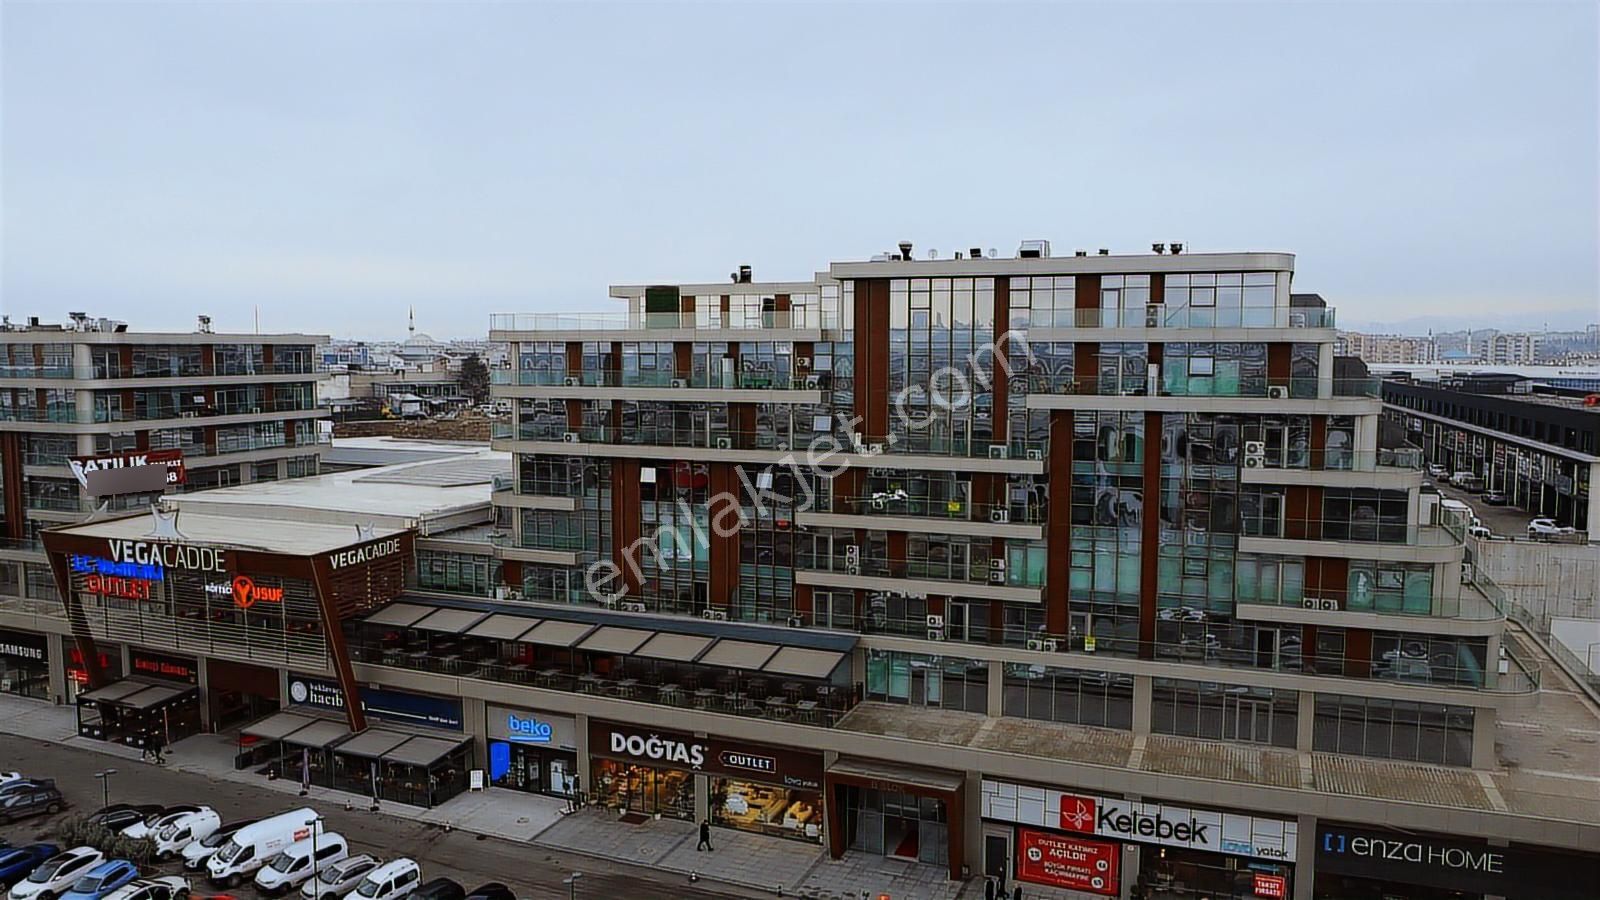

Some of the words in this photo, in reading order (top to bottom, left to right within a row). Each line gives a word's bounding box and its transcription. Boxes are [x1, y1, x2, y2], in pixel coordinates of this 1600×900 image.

[0, 643, 42, 659] SAMSUNG
[508, 715, 551, 737] beko
[610, 732, 704, 770] DOĞTAŞ
[729, 755, 772, 769] OUTLET
[1098, 806, 1209, 844] Kelebek
[1256, 846, 1289, 858] yatak
[1351, 836, 1423, 863] enza
[1427, 846, 1505, 874] HOME
